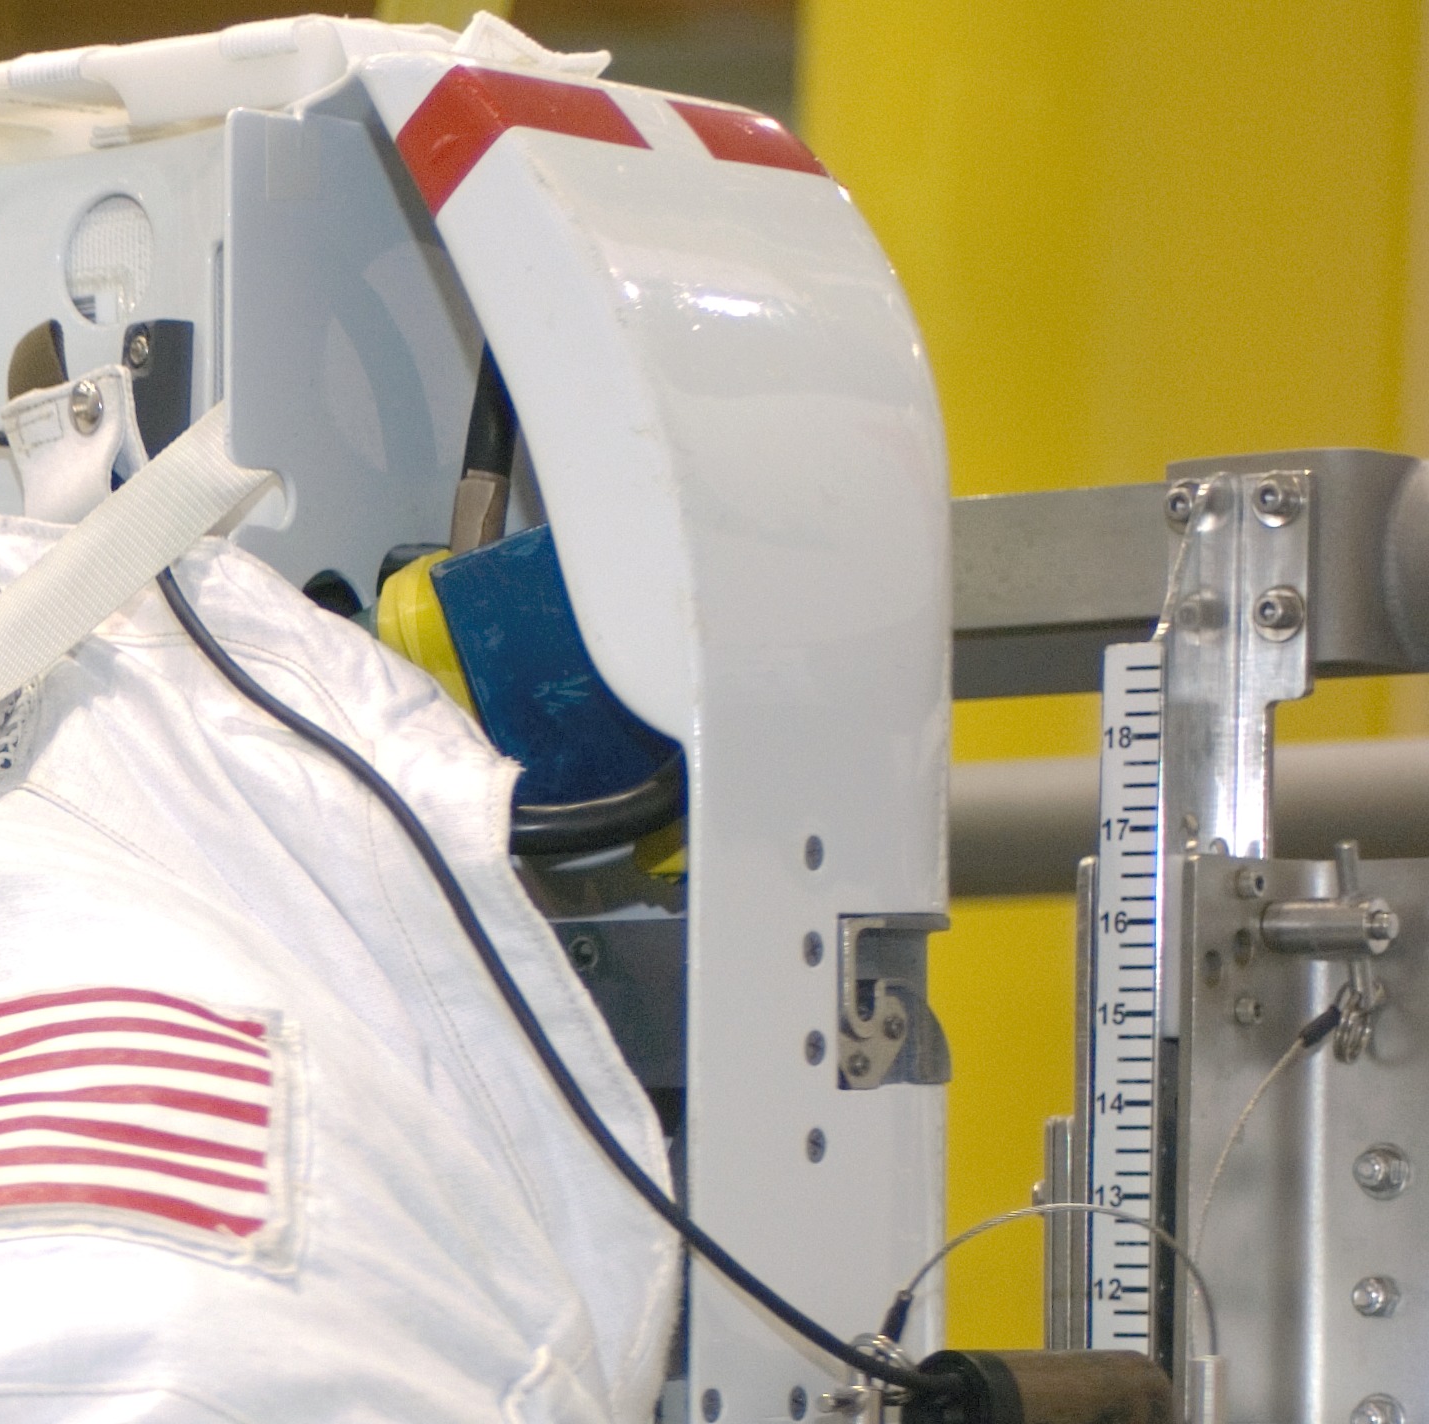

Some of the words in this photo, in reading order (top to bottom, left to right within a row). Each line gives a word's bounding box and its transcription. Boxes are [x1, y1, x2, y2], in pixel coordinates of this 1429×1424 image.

[1104, 726, 1132, 749] 18
[1102, 818, 1130, 841] 17
[1100, 911, 1128, 934] 16
[1097, 1003, 1125, 1025] 15
[1096, 1092, 1124, 1115] 14
[1094, 1185, 1123, 1207] 13
[1093, 1278, 1121, 1300] 12
